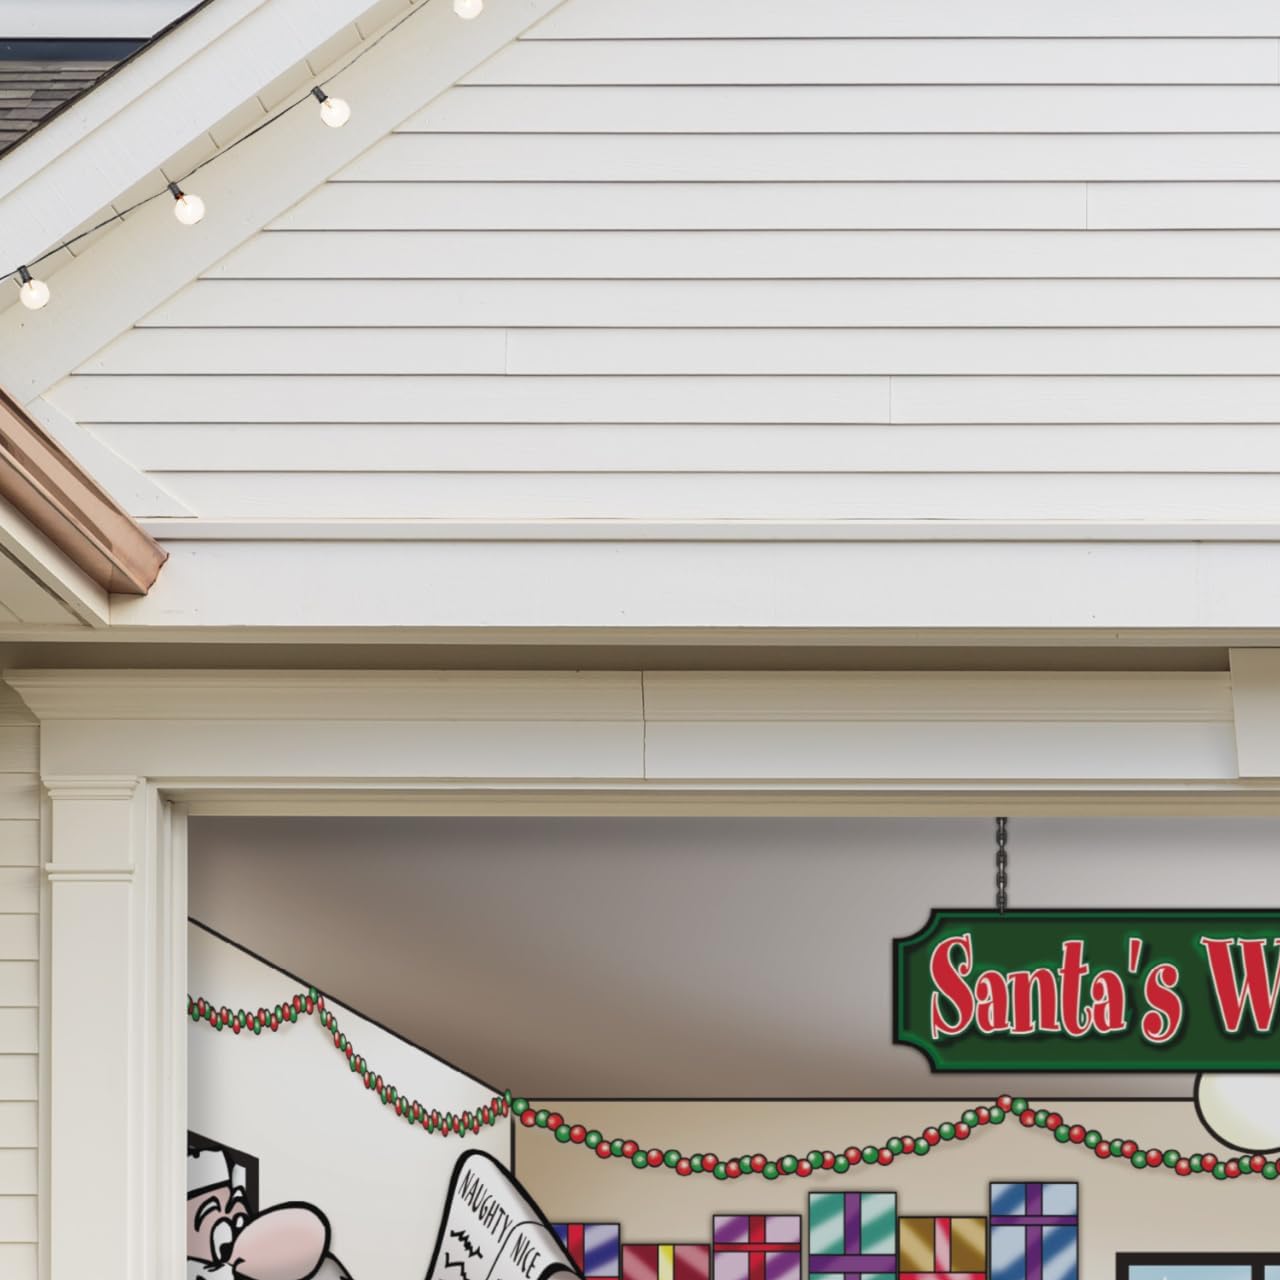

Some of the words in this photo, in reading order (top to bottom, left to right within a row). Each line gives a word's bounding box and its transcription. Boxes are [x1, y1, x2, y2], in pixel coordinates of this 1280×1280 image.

[929, 932, 1184, 1044] Santa's
[457, 1168, 514, 1244] NAUGHTY
[509, 1231, 542, 1280] NICE
